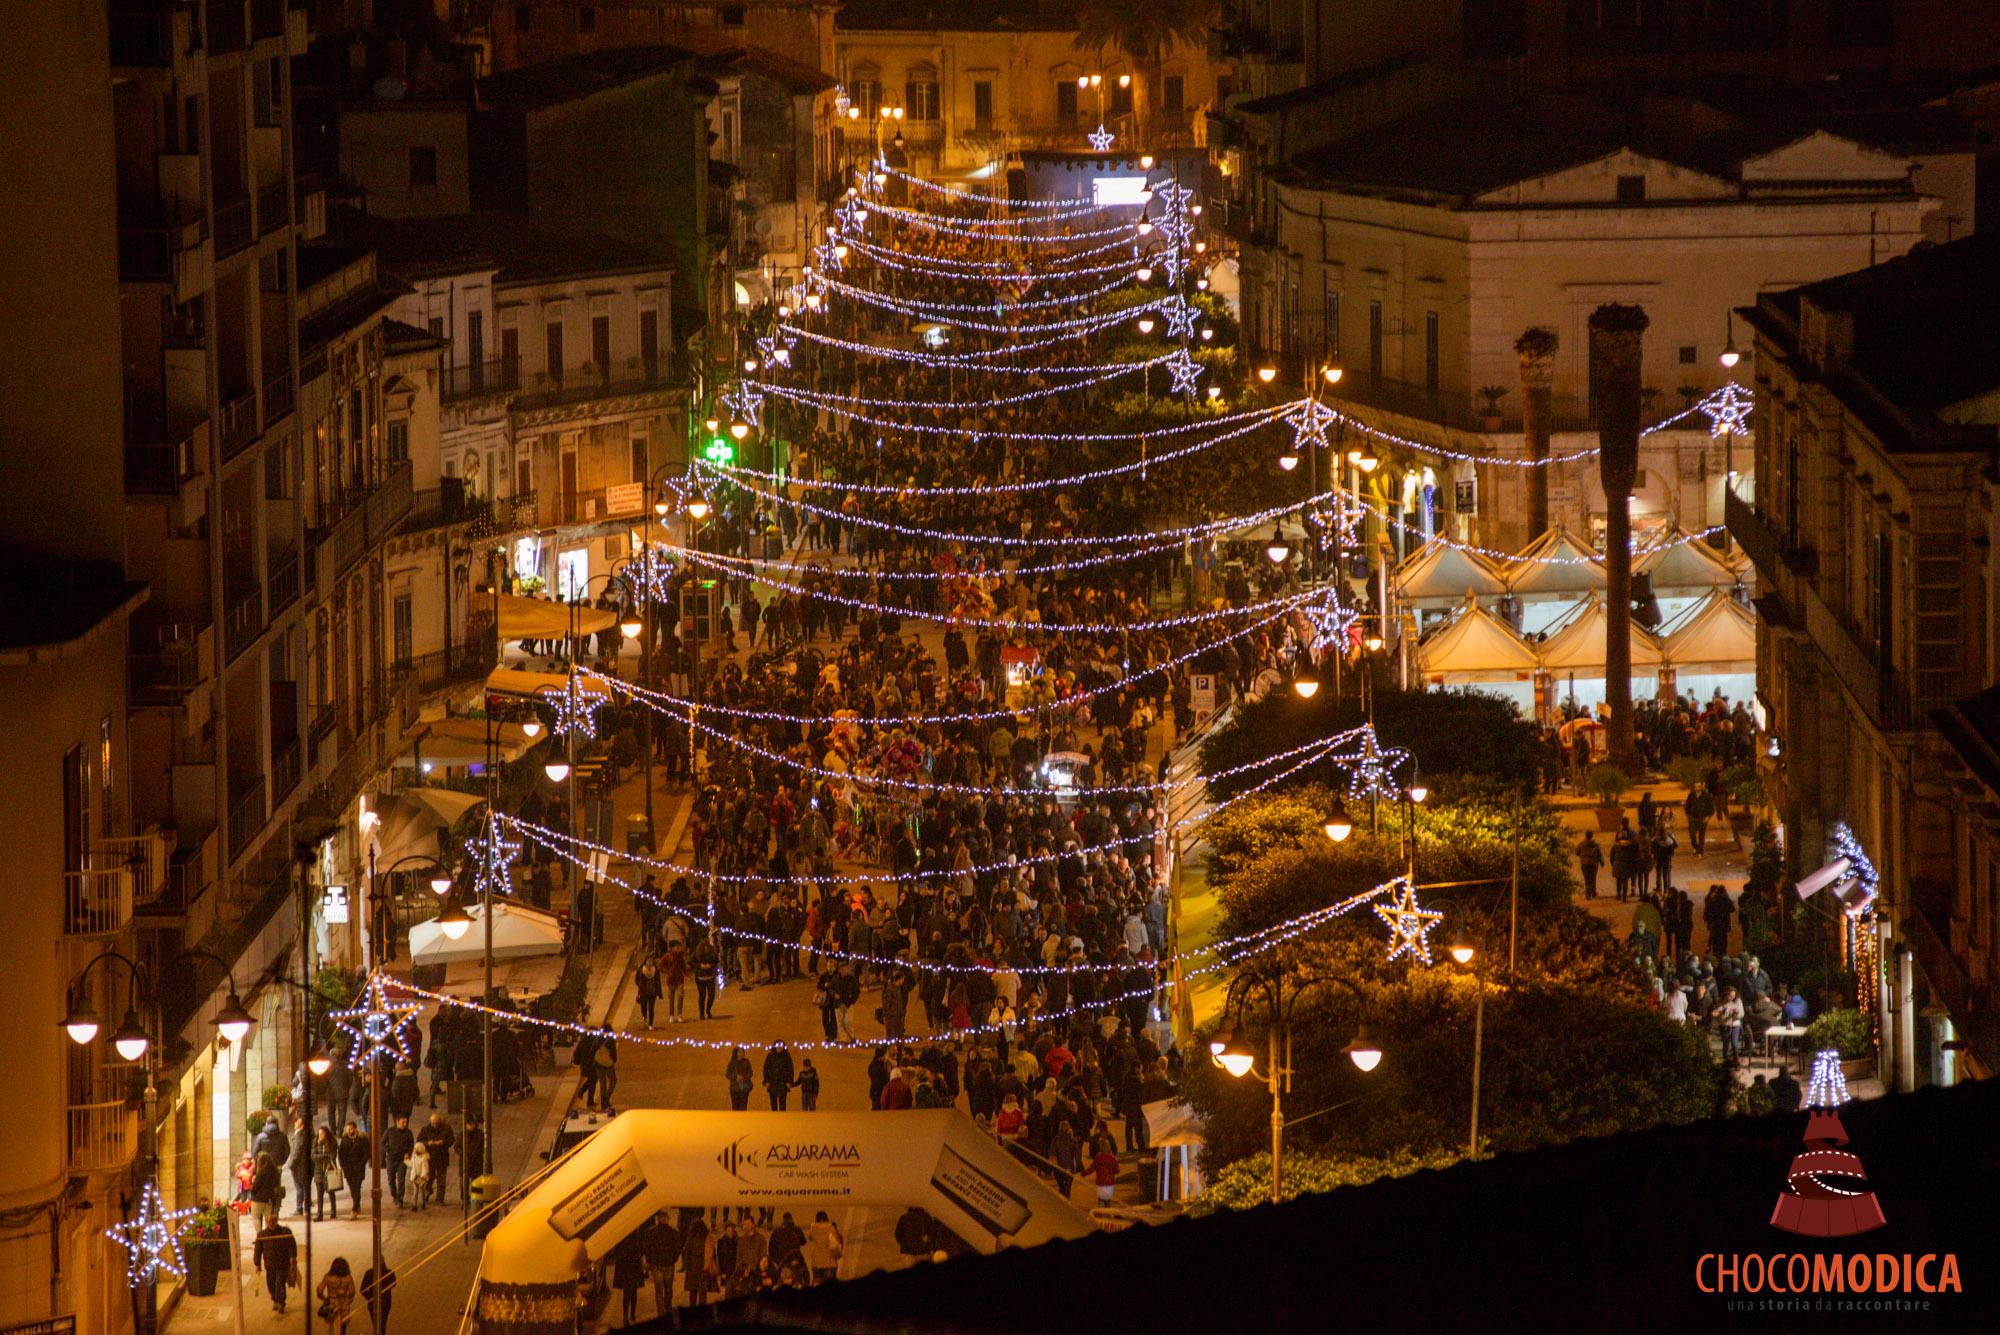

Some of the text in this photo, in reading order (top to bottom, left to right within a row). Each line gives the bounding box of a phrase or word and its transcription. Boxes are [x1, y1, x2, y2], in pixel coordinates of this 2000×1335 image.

[1198, 679, 1207, 690] P
[766, 1144, 860, 1161] AQUARAMA
[592, 1168, 623, 1194] PASSIONE
[779, 1170, 848, 1179] CAR WASH SYSTEM
[589, 1184, 615, 1204] RICERCA
[738, 1187, 850, 1197] www.aquarama.it
[573, 1197, 610, 1228] ANTICIPANO
